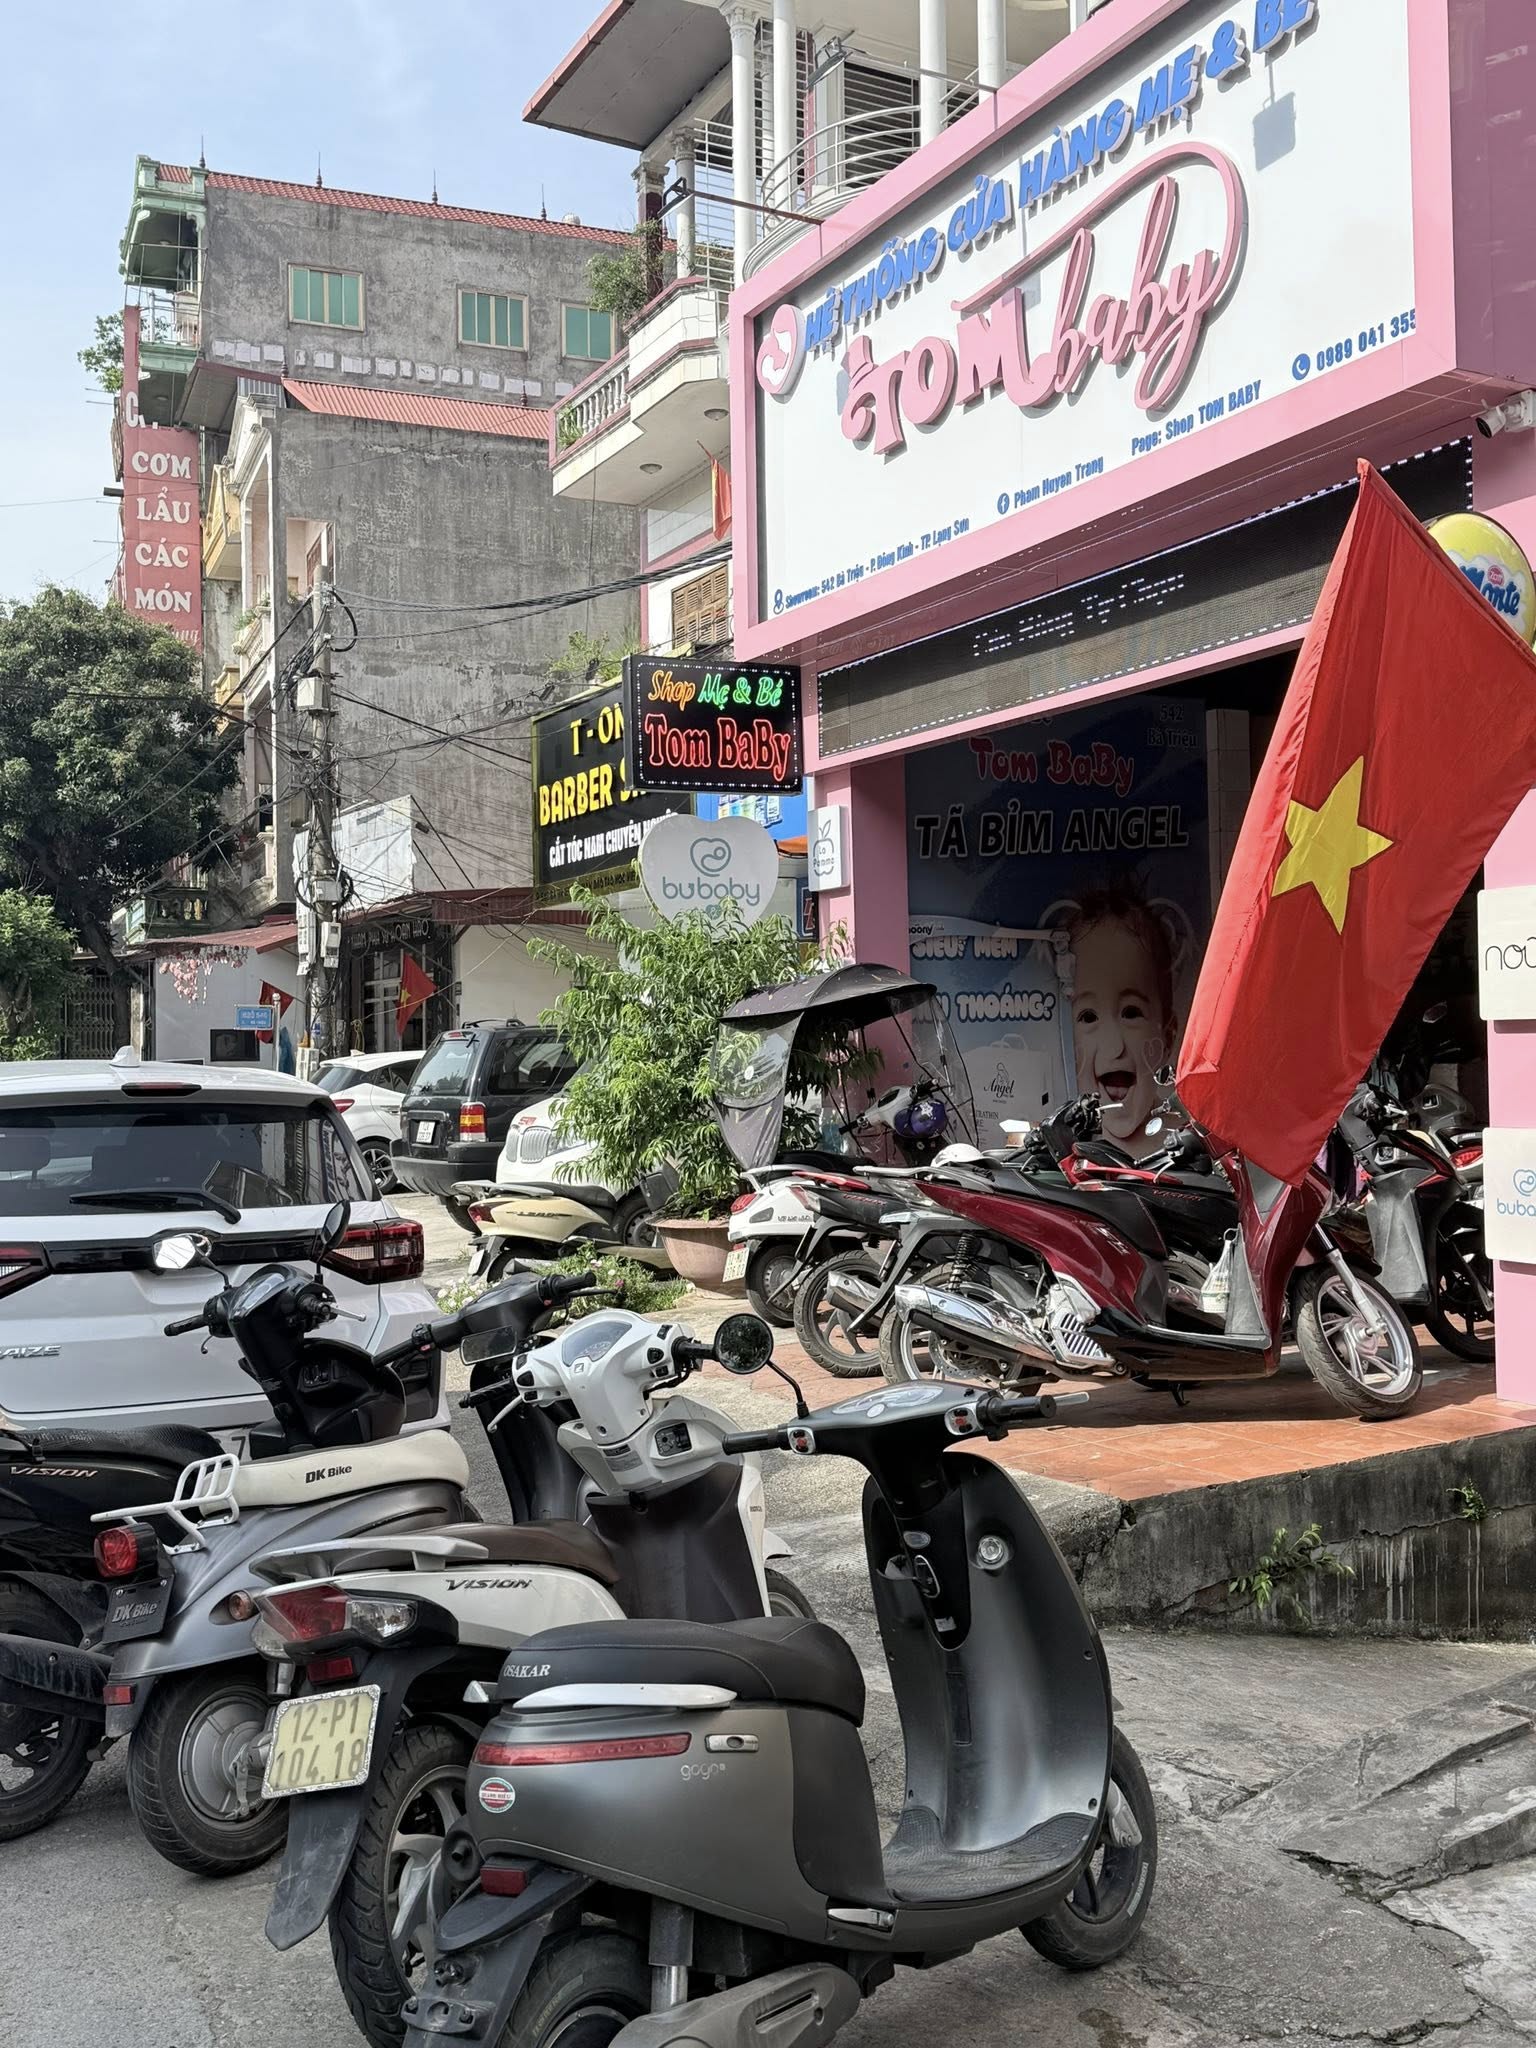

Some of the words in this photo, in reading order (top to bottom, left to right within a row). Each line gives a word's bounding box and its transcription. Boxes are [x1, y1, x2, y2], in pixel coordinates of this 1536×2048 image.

[805, 287, 839, 352] HỆ
[843, 227, 942, 325] THỐNG
[948, 175, 1010, 252] CỬA
[1019, 99, 1129, 209] HÀNG
[1134, 44, 1200, 132] MẸ
[1206, 20, 1241, 78] &
[1316, 338, 1353, 371] 0989
[1358, 323, 1385, 352] 041
[841, 287, 1062, 456] TOM
[1131, 431, 1162, 456] Page:
[1165, 414, 1194, 440] Shop
[1198, 397, 1225, 424] TOM
[1228, 379, 1262, 412] BABY
[131, 451, 191, 479] CƠM
[1014, 484, 1041, 509] Pham
[1042, 470, 1072, 495] Huyen
[1075, 456, 1105, 482] Trang
[136, 486, 192, 524] LẨU
[135, 537, 189, 569] CÁC
[134, 582, 192, 613] MÓN
[821, 576, 835, 594] 542
[836, 571, 846, 588] Bà
[648, 670, 695, 711] Shop
[698, 673, 731, 710] Mẹ
[733, 677, 752, 705] &
[755, 677, 784, 707] Bé
[1159, 704, 1184, 722] 542
[570, 718, 582, 756] T
[645, 713, 712, 768] Tom
[717, 717, 791, 782] BaBy
[968, 736, 1038, 783] Tom
[1046, 739, 1135, 798] BaBy
[539, 763, 613, 826] BARBER
[550, 836, 566, 868] CẮT
[567, 835, 583, 863] TÓC
[584, 832, 605, 860] NAM
[606, 819, 642, 856] CHUYÊN
[914, 802, 968, 860] TÃ
[979, 798, 1054, 857] BỈM
[1063, 806, 1190, 853] ANGEL
[663, 876, 760, 906] bubaby
[908, 923, 934, 936] oony
[983, 1077, 1016, 1098] Angel
[0, 1345, 61, 1359] AIZE
[11, 1466, 98, 1478] VISION
[305, 1468, 326, 1484] DK
[328, 1464, 352, 1478] Bike
[445, 1579, 533, 1592] VISION
[112, 1603, 135, 1623] DK
[132, 1602, 158, 1618] Bike
[503, 1664, 551, 1678] OSAKAR
[293, 1696, 360, 1743] 12-P1
[275, 1738, 365, 1789] 104.18
